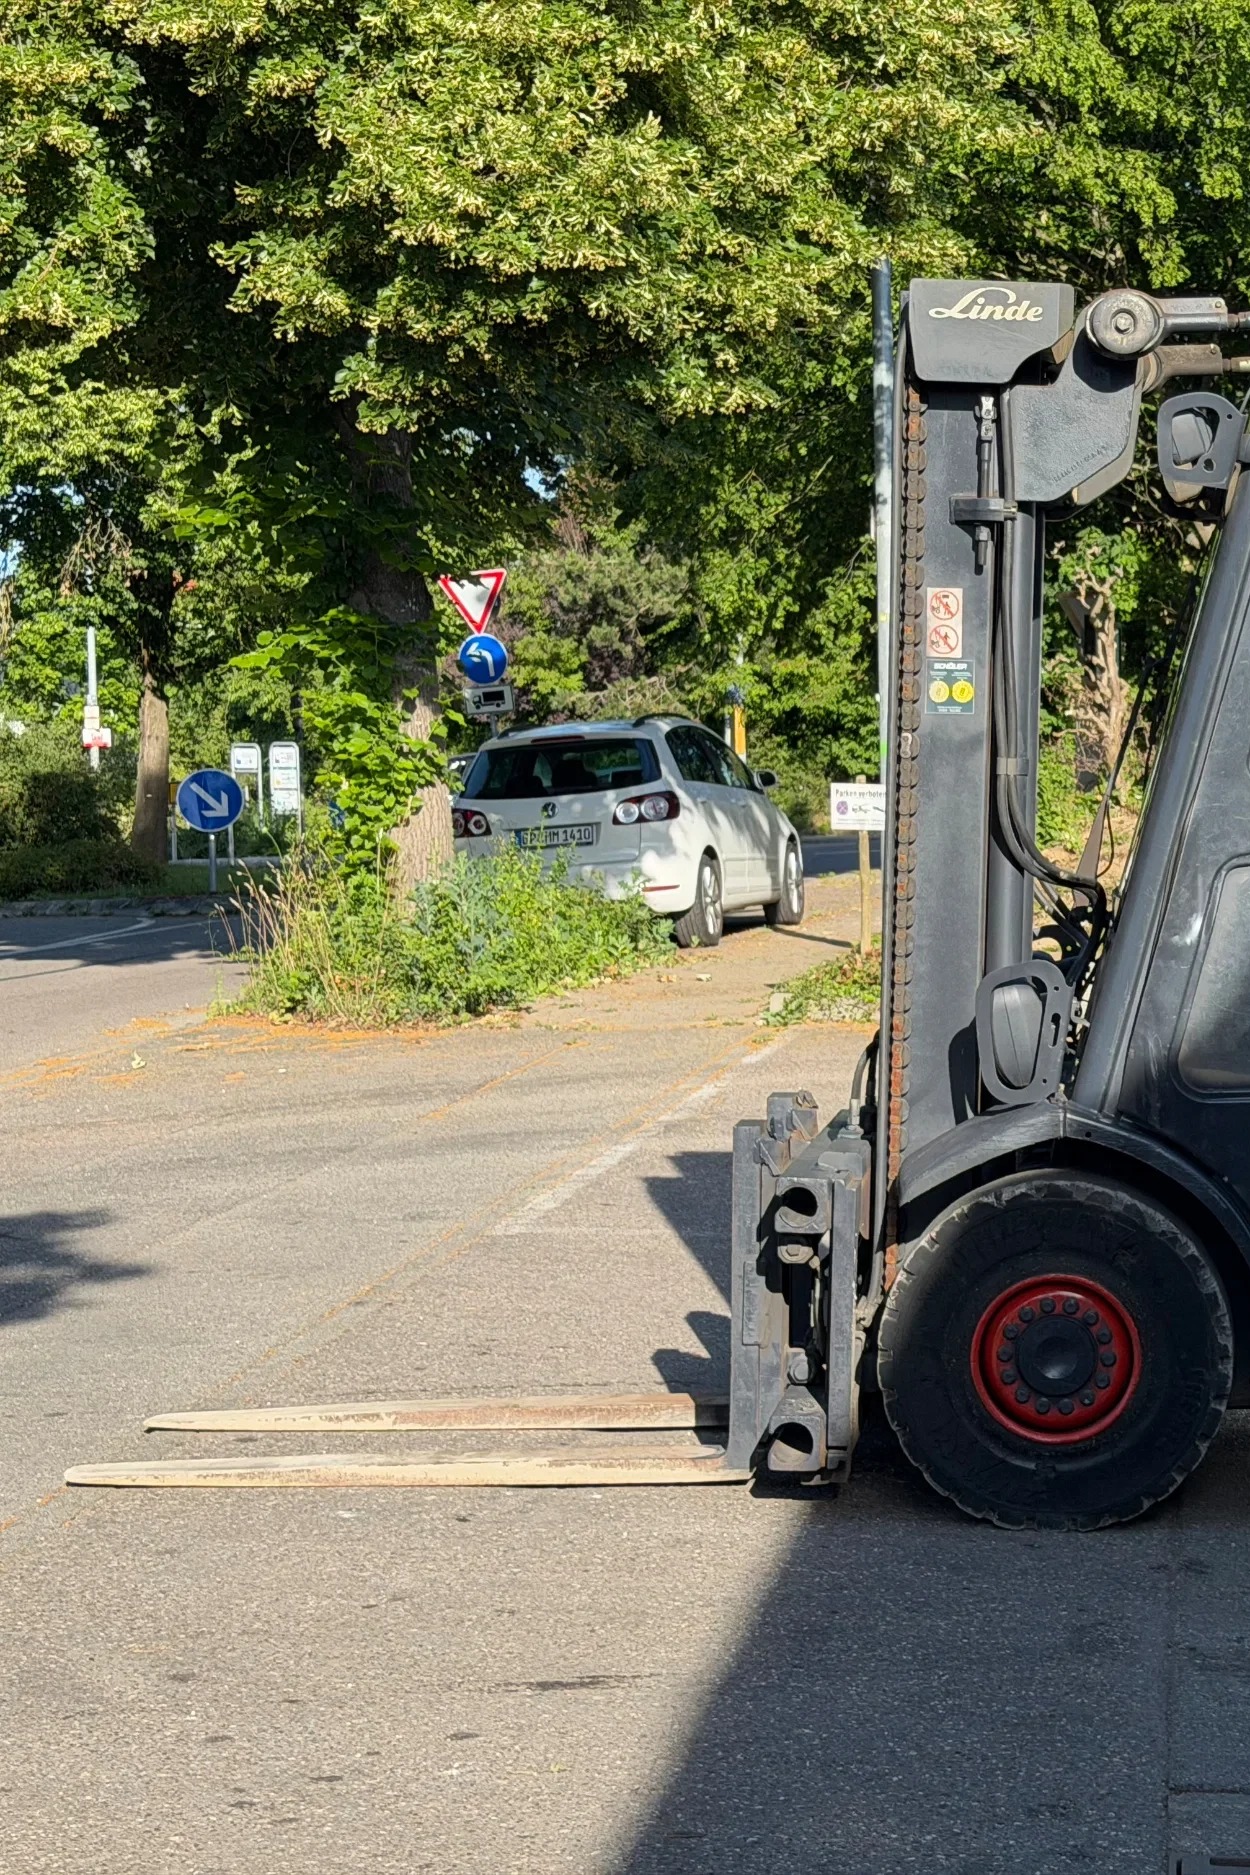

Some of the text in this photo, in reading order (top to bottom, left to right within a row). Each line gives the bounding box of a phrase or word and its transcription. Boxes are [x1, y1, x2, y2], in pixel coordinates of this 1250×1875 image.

[928, 286, 1043, 322] Linde
[835, 788, 857, 797] Parken
[562, 827, 591, 842] 1410
